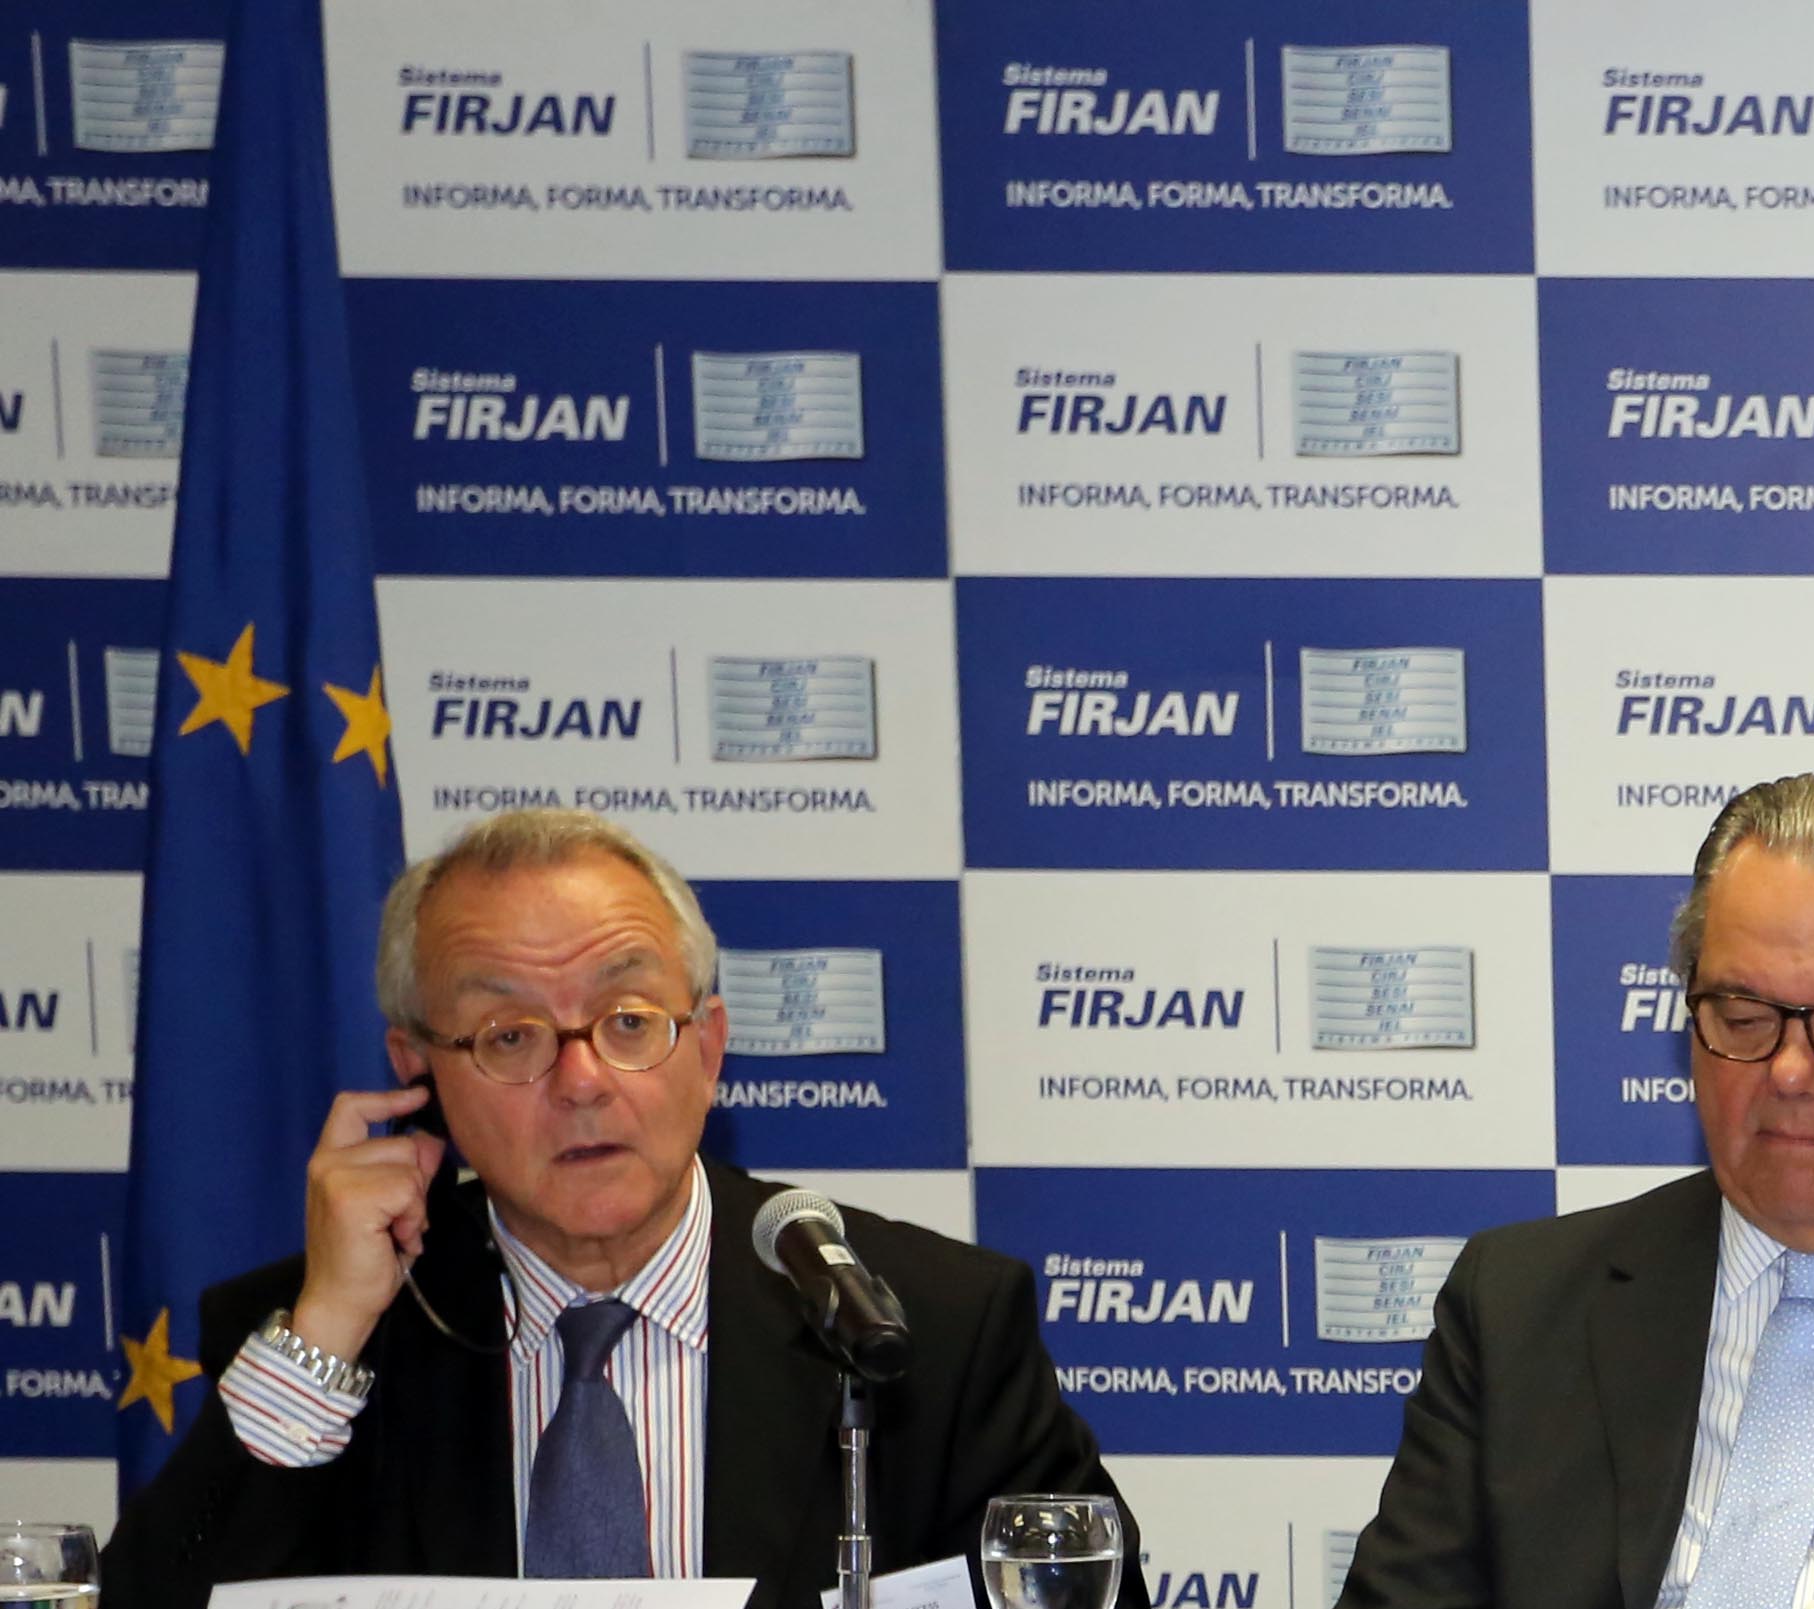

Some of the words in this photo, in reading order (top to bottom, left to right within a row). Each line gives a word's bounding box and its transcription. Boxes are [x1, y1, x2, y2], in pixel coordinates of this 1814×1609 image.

[401, 93, 616, 136] FIRJAN
[1005, 92, 1220, 136] FIRJAN
[1604, 94, 1814, 136] FIRJAN
[414, 397, 630, 441] FIRJAN
[1017, 393, 1227, 435] FIRJAN
[429, 673, 530, 691] Sistema
[1025, 666, 1128, 688] Sistema
[1615, 669, 1716, 689] Sistema
[431, 698, 642, 740] FIRJAN
[1027, 692, 1240, 736] FIRJAN
[1036, 963, 1135, 982] Sistema
[1038, 989, 1245, 1029] FIRJAN
[1039, 1076, 1169, 1100] INFORMA,
[1176, 1077, 1277, 1101] FORMA,
[1280, 1078, 1472, 1101] TRANSFORMA.
[1043, 1251, 1146, 1275] Sistema
[1044, 1279, 1255, 1324] FIRJAN
[1183, 1367, 1287, 1397] FORMA,
